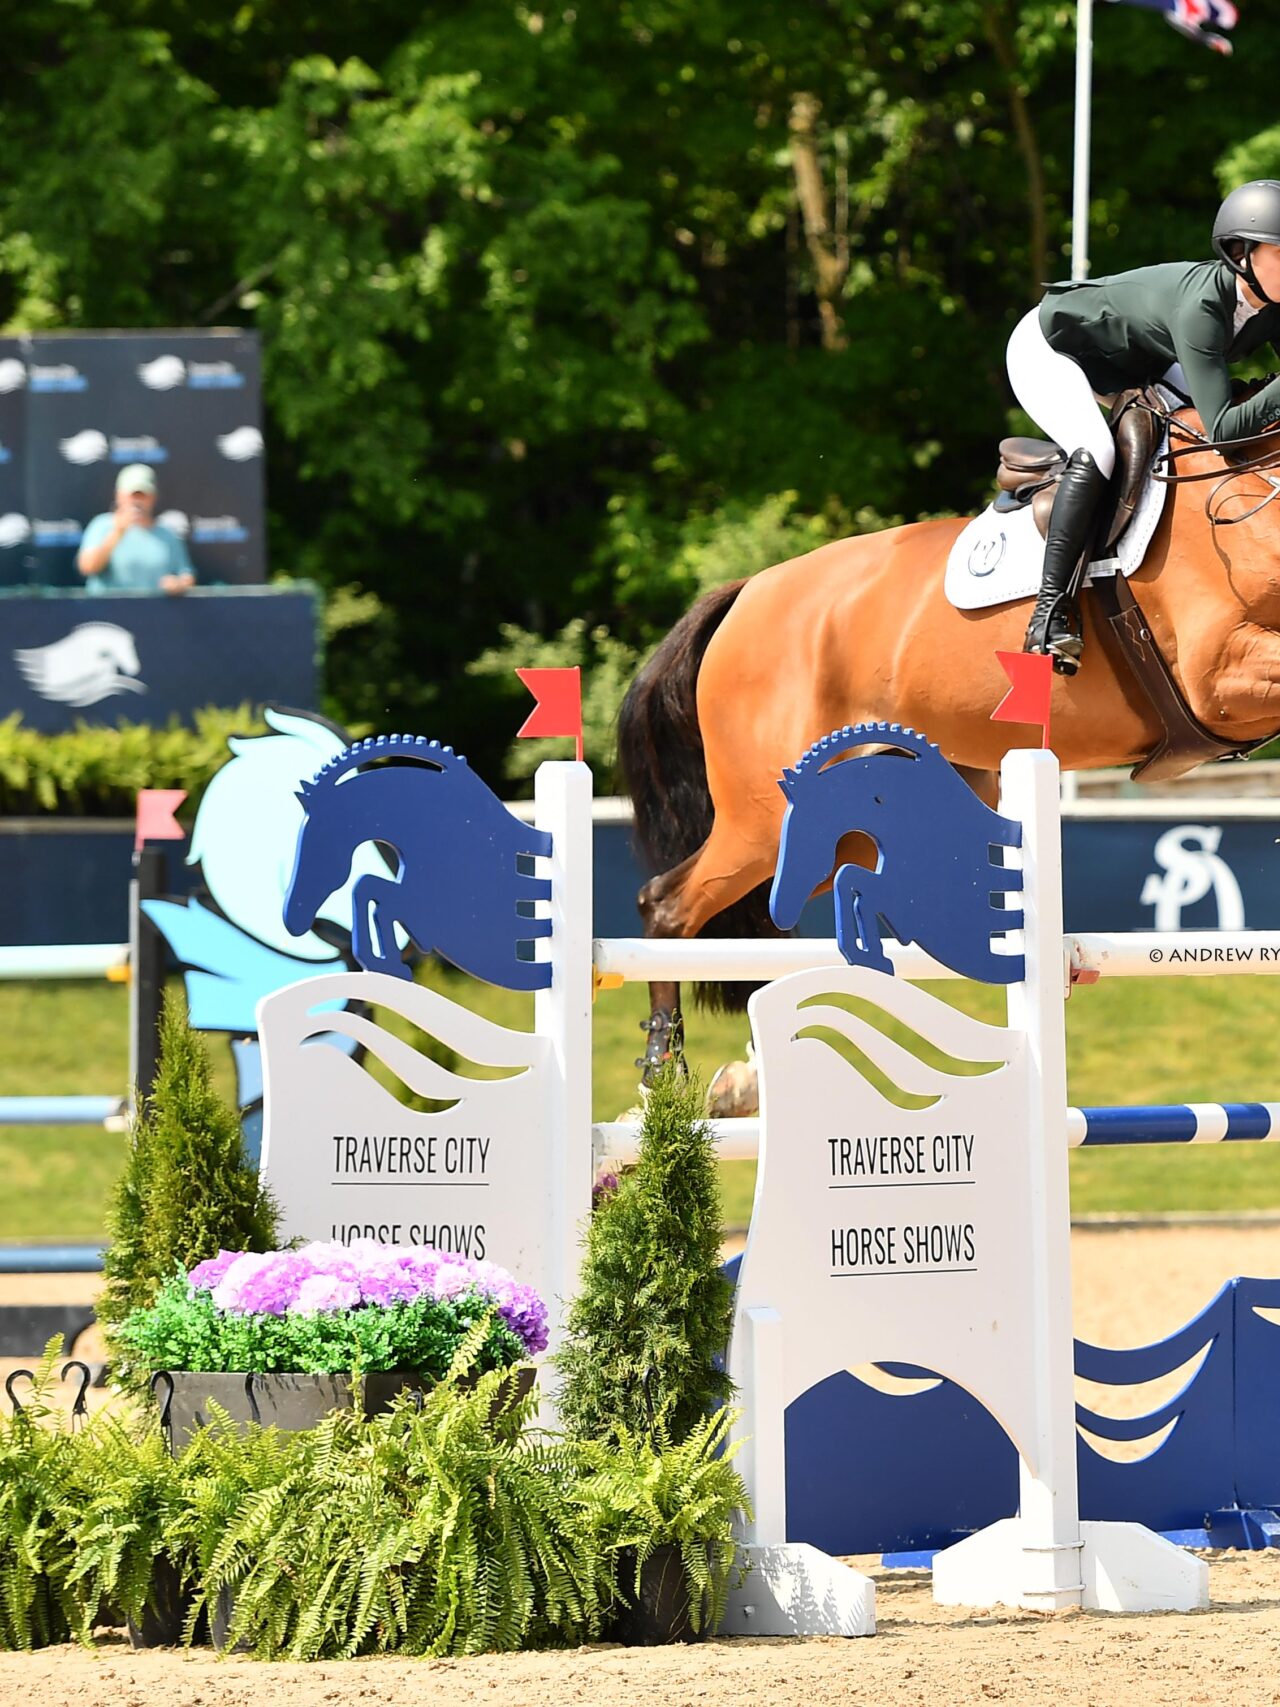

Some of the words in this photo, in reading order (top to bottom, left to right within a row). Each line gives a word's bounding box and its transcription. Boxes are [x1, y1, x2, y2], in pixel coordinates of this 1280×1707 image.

[333, 1137, 437, 1173] TRAVERSE
[445, 1138, 489, 1173] CITY
[828, 1136, 925, 1175] TRAVERSE
[933, 1135, 974, 1172] CITY
[832, 1227, 896, 1266] HORSE
[904, 1224, 974, 1263] SHOWS
